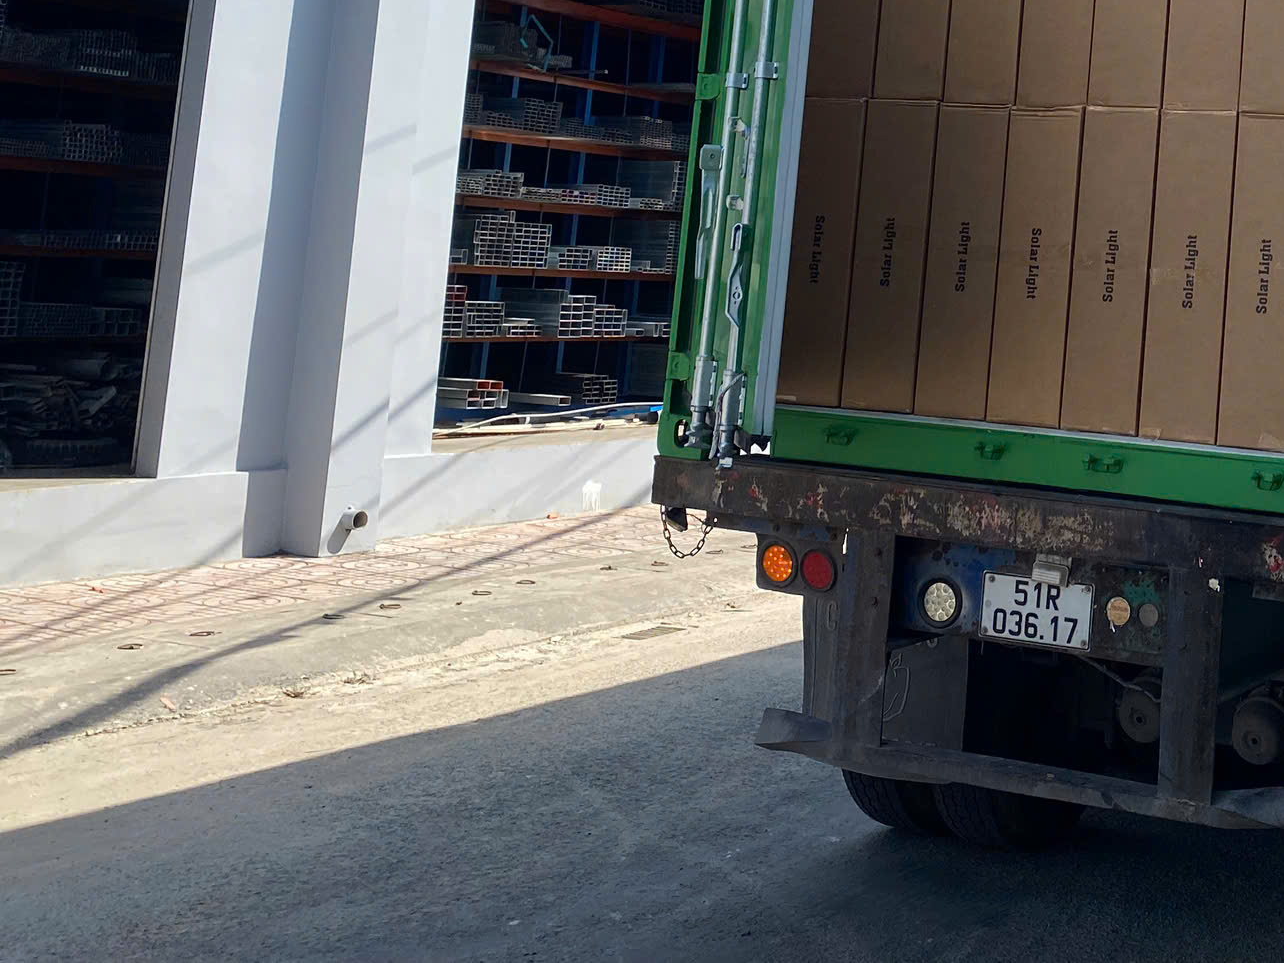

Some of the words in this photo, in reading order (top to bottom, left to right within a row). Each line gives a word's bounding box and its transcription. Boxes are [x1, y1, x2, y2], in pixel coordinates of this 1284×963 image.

[812, 215, 826, 248] Solar
[882, 217, 897, 251] Light
[957, 221, 972, 256] Light
[1029, 227, 1043, 262] Solar
[1104, 229, 1120, 265] Light
[808, 250, 823, 284] Light
[879, 253, 893, 287] Solar
[1183, 235, 1199, 271] Light
[1257, 238, 1274, 275] Light
[954, 257, 968, 293] Solar
[1025, 264, 1040, 300] Light
[1101, 267, 1116, 303] Solar
[1181, 273, 1195, 309] Solar
[1255, 277, 1269, 315] Solar
[1013, 579, 1062, 612] 51R
[992, 608, 1079, 645] 036.17
